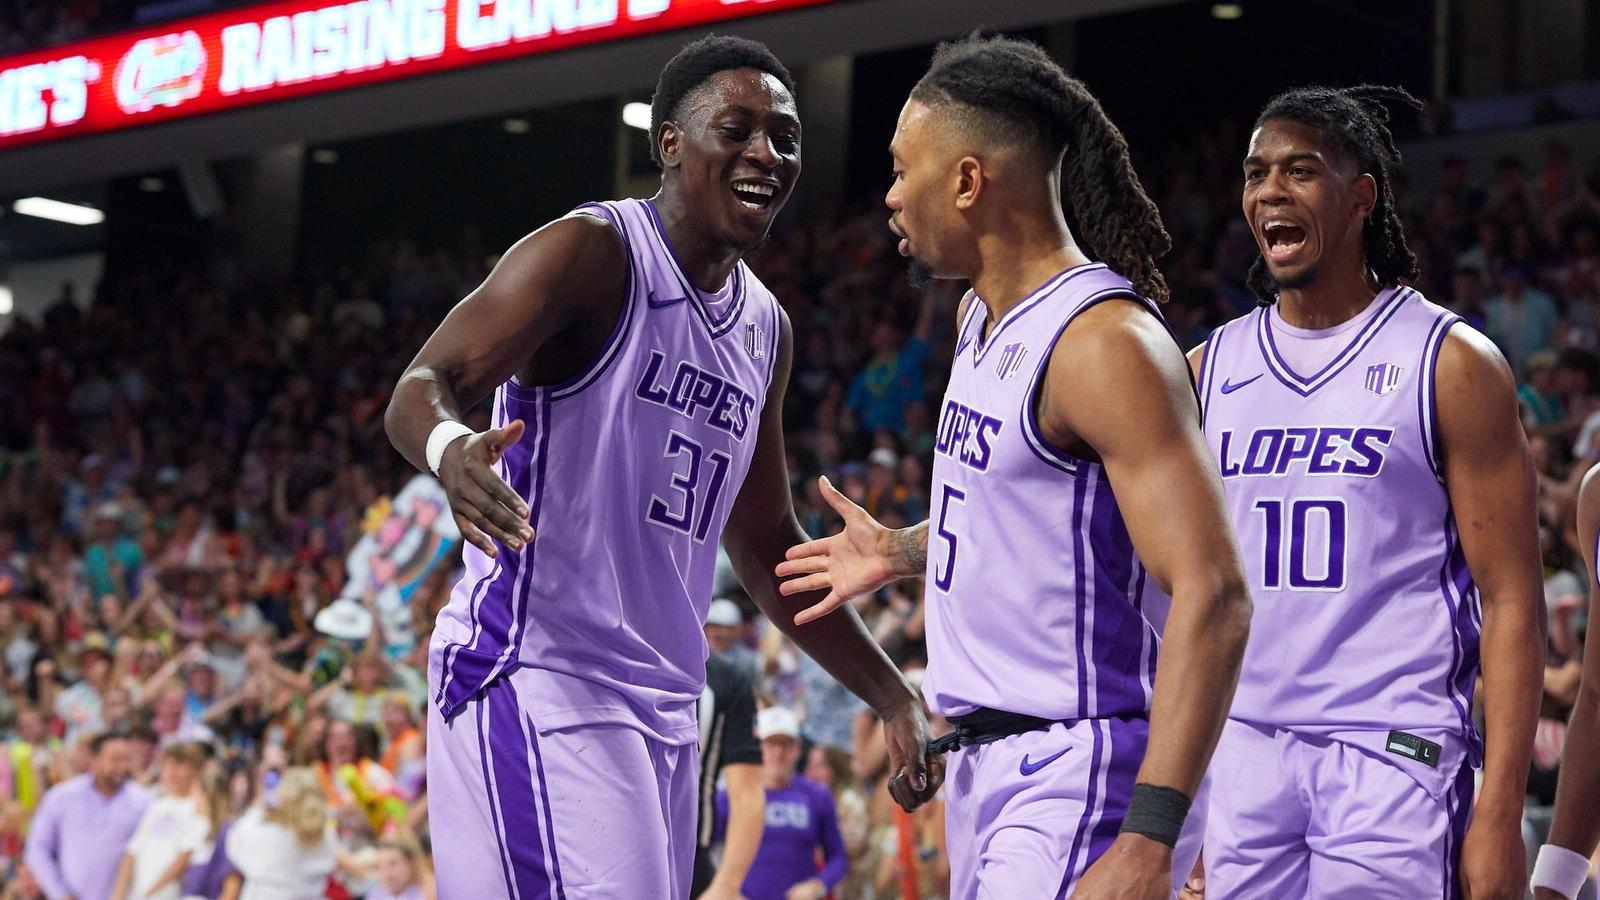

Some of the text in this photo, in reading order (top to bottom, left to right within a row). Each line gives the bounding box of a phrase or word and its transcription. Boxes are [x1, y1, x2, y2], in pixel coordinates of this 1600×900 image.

[219, 0, 446, 95] RAISING
[634, 348, 757, 443] LOPES
[934, 398, 1006, 475] OPES
[645, 428, 733, 545] 31
[1218, 425, 1396, 480] LOPES
[933, 480, 968, 596] 5
[1251, 496, 1349, 593] 10
[1424, 747, 1430, 758] L
